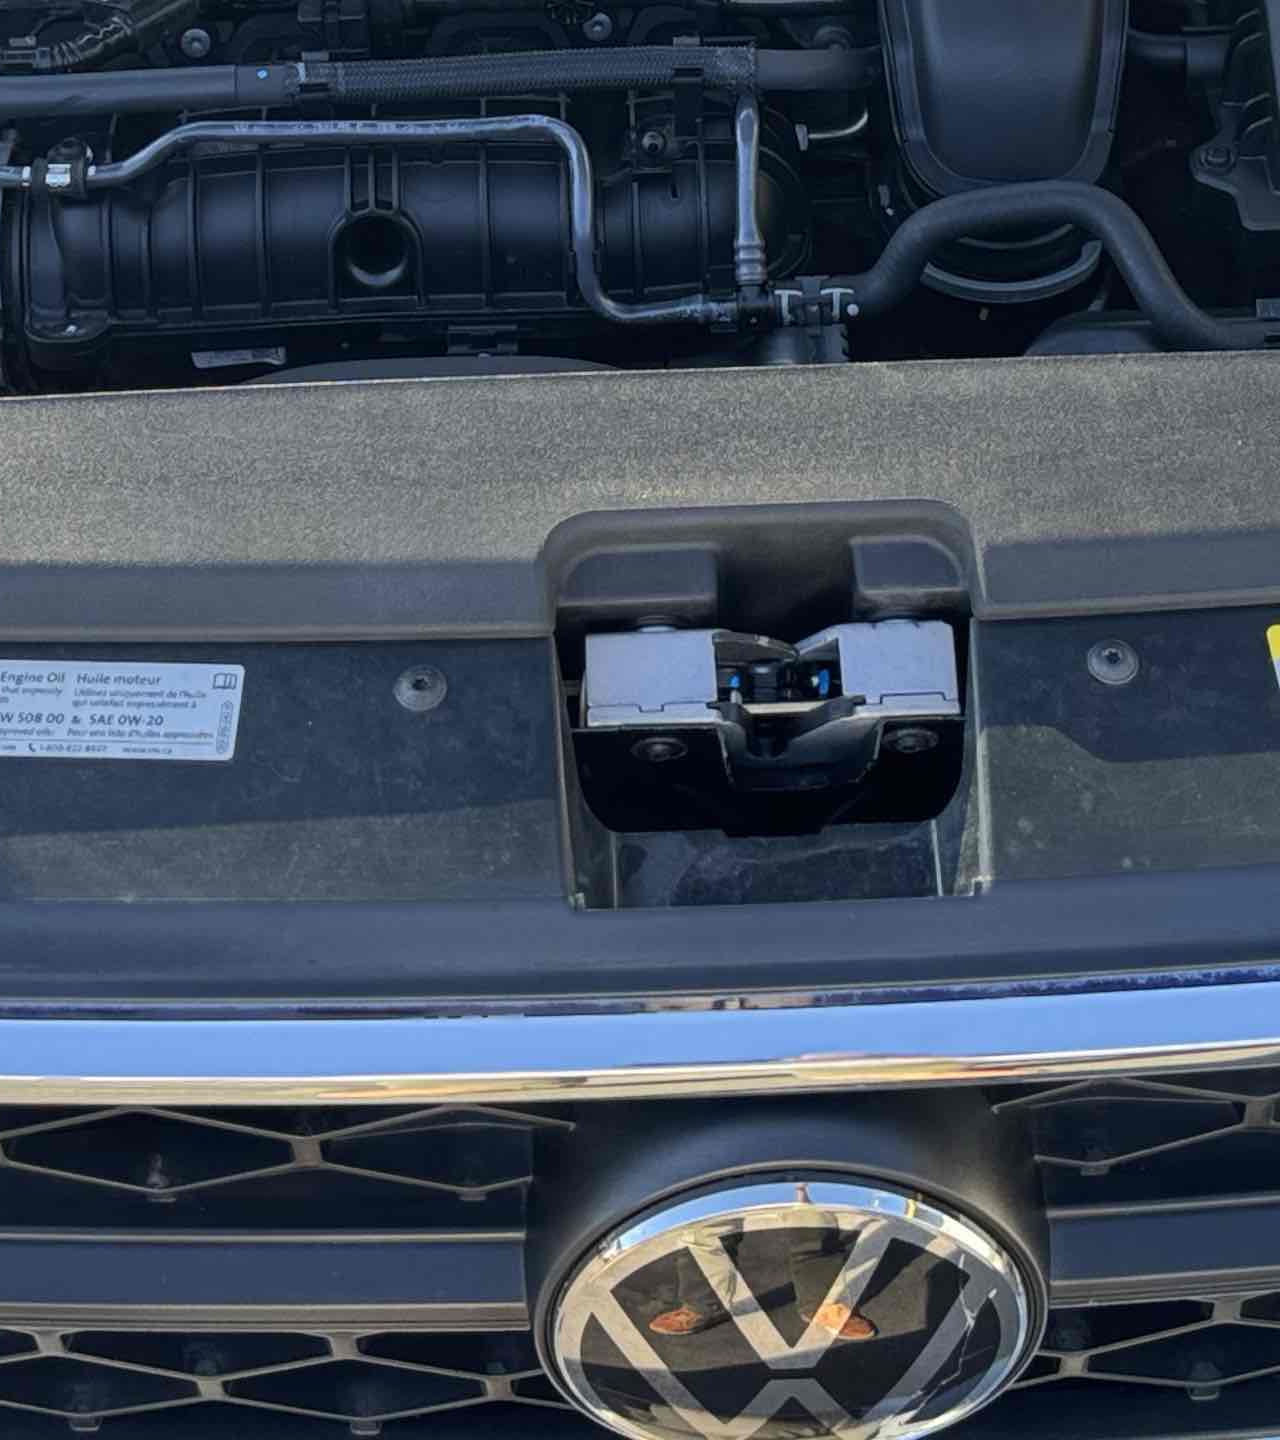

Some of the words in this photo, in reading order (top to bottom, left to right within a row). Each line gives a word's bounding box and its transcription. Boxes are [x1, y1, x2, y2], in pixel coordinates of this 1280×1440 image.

[0, 672, 44, 685] Engine
[47, 672, 65, 683] Oil
[76, 673, 110, 684] Huile
[113, 674, 162, 685] moteur
[17, 713, 43, 724] 508
[45, 713, 65, 724] 00
[72, 714, 81, 724] &
[88, 714, 115, 725] SAE
[117, 714, 164, 726] 0W-20
